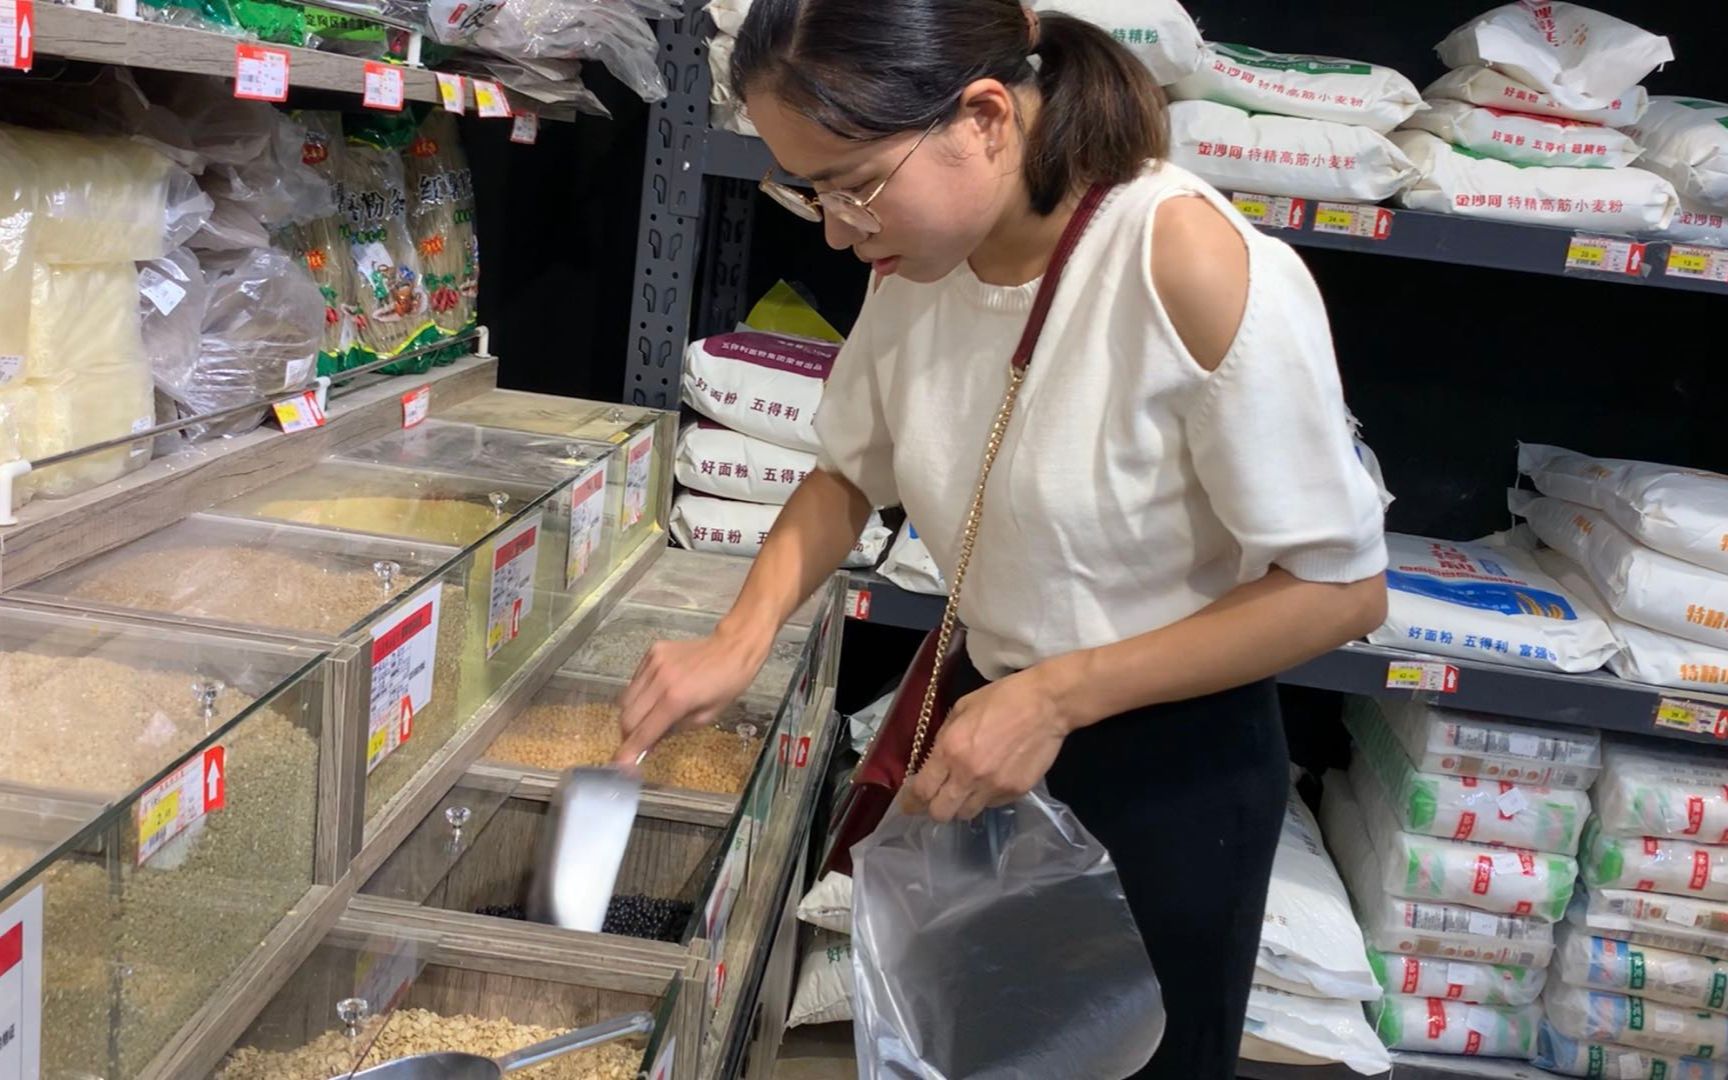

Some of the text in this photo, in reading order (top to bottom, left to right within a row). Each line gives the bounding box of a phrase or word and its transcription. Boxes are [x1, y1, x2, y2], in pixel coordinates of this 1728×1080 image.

[1508, 196, 1624, 214] 特精高筋小麦粉
[750, 398, 800, 422] 五得利
[701, 460, 749, 479] 好面粉
[693, 526, 742, 544] 好面粉
[1408, 626, 1453, 645] 好面粉
[1463, 634, 1509, 653] 五得利
